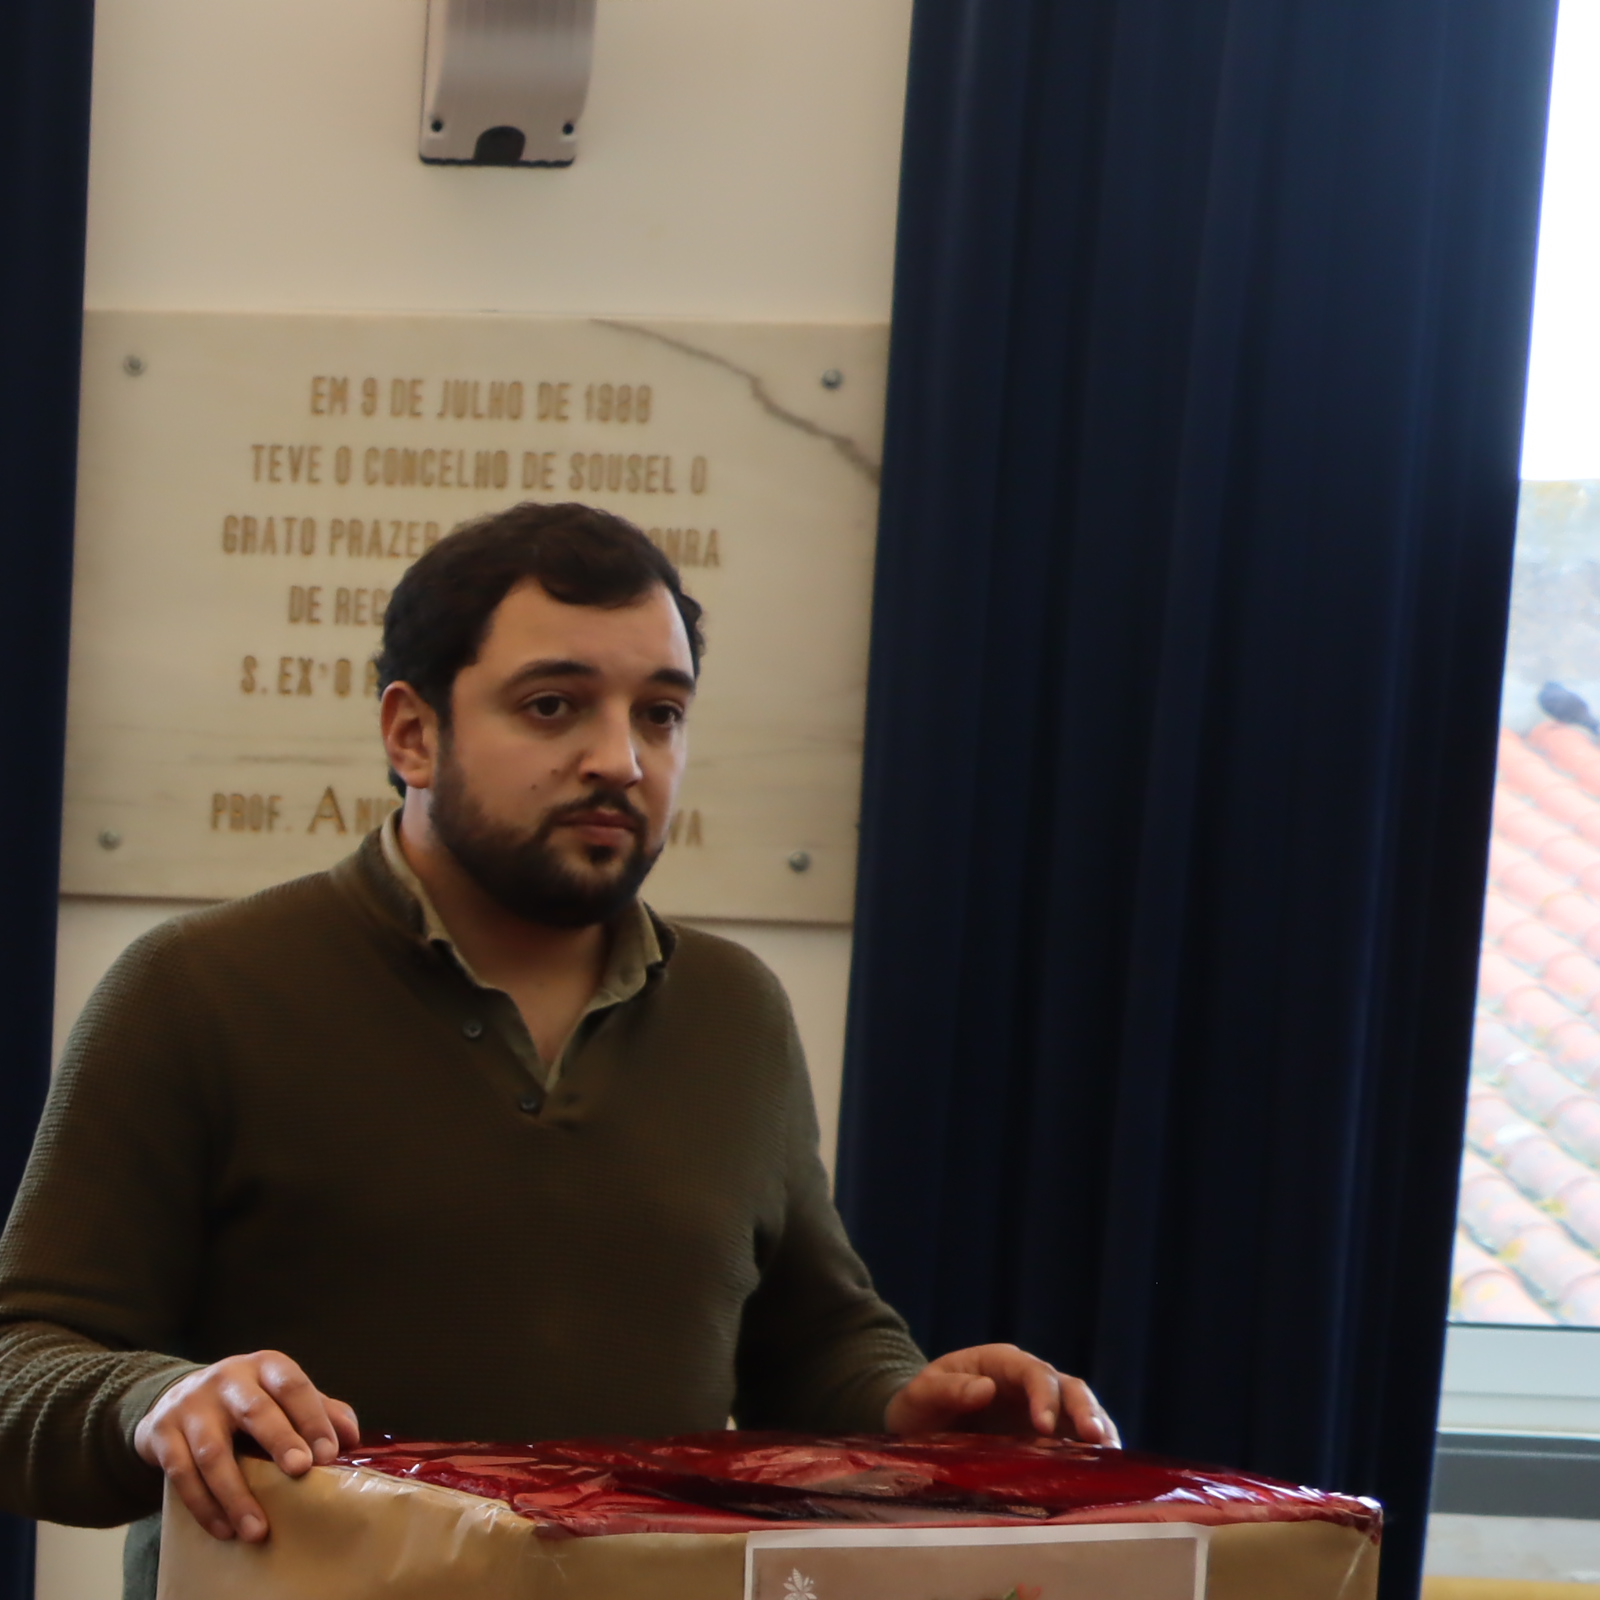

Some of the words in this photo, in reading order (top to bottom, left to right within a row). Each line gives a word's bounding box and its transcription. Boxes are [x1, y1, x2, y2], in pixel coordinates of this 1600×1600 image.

[311, 376, 349, 416] EM
[361, 377, 378, 418] 9
[390, 378, 424, 418] DE
[437, 379, 523, 421] JULHO
[537, 382, 572, 422] DE
[250, 444, 322, 484] TEVE
[334, 445, 352, 486] O
[364, 447, 508, 489] CONCELHO
[522, 451, 556, 491] DE
[568, 452, 676, 494] SOUSEL
[690, 455, 708, 494] O
[222, 515, 317, 556] GRATO
[288, 585, 323, 625] DE
[210, 791, 292, 833] PROF.
